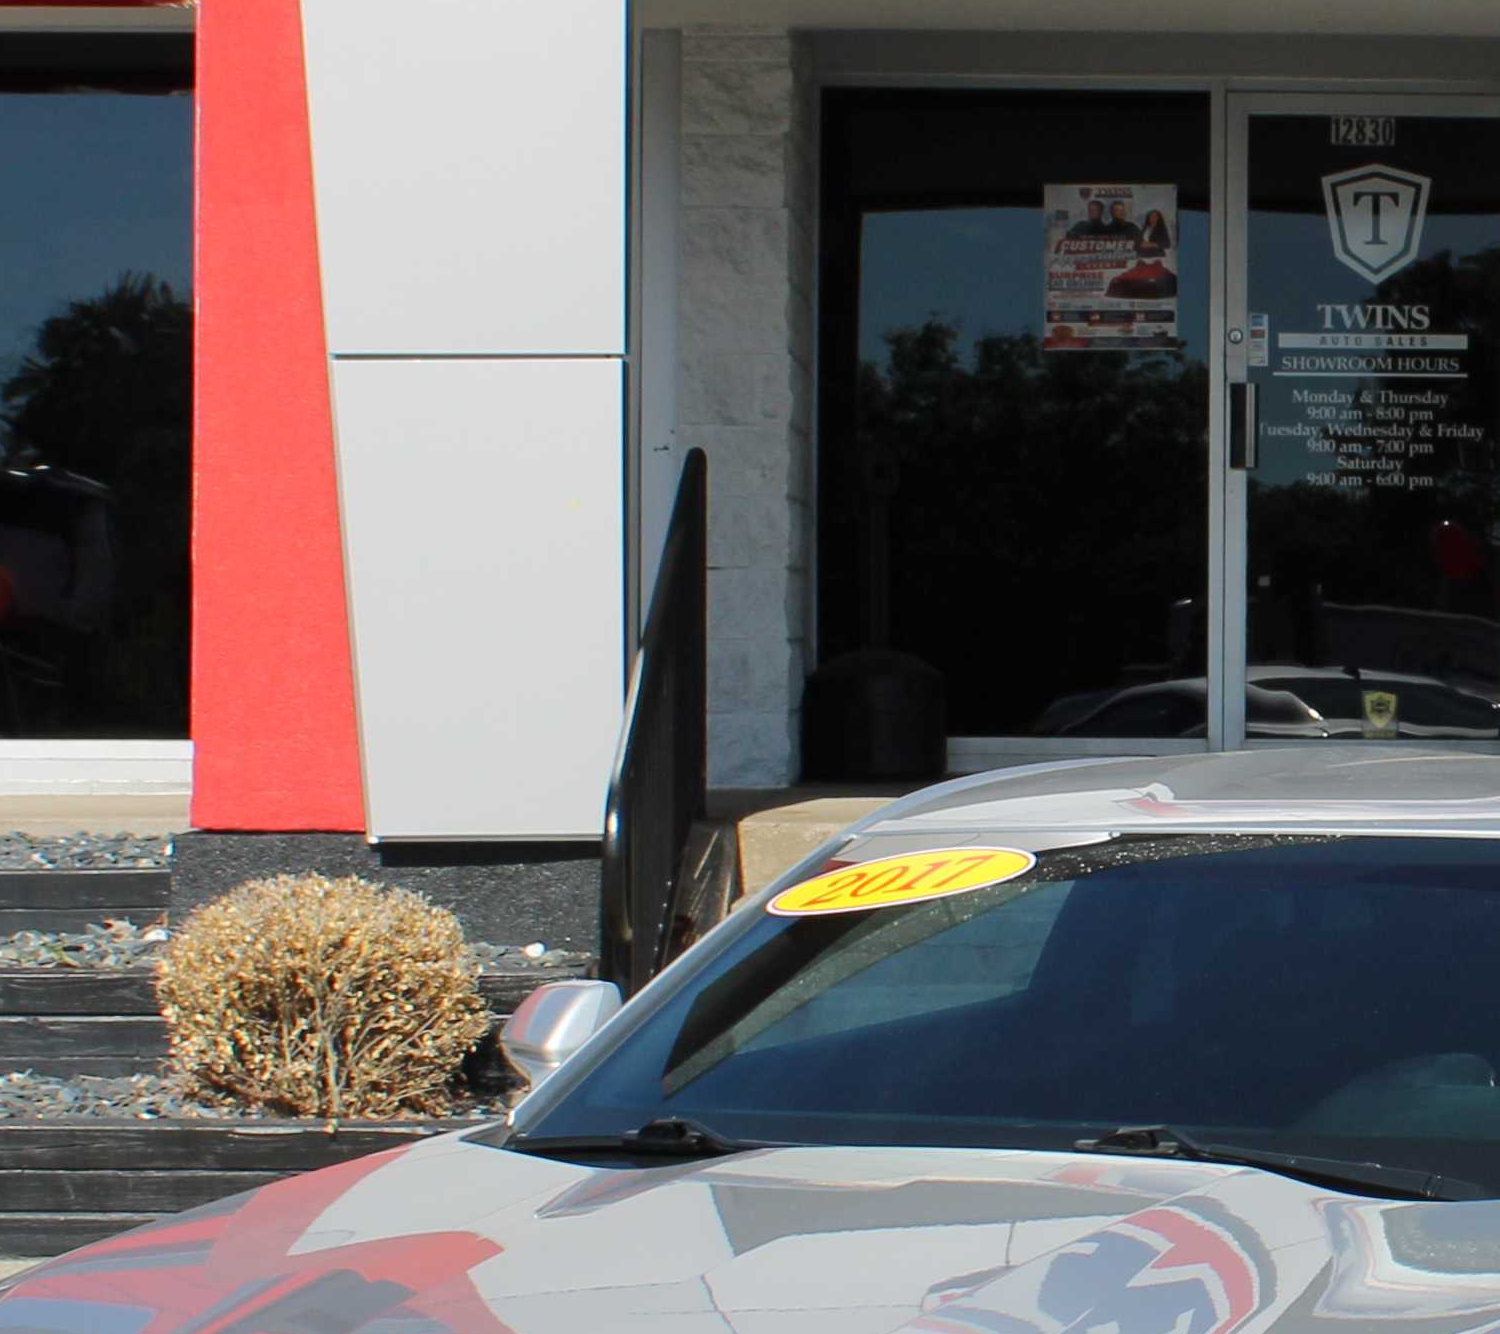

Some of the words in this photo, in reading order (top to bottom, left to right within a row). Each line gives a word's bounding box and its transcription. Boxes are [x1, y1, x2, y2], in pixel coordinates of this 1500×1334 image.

[1334, 119, 1394, 144] 12830
[1353, 192, 1399, 245] T
[1060, 240, 1135, 251] CUSTOMER
[1316, 304, 1430, 329] TWINS
[1319, 336, 1363, 346] AUTO
[1375, 336, 1428, 347] SALES
[1282, 355, 1392, 371] SHOWROOM
[1398, 357, 1460, 372] HOURS
[1292, 389, 1354, 405] Monday
[1360, 391, 1373, 404] &
[1379, 390, 1449, 407] Thursday
[1306, 407, 1336, 419] 9:00
[1339, 410, 1363, 419] am
[1375, 408, 1404, 420] 8:00
[1409, 410, 1434, 423] pm
[1327, 423, 1413, 439] Wednesday
[1420, 425, 1432, 437] &
[1437, 424, 1484, 440] Friday
[1306, 440, 1336, 452] 9:00
[1339, 443, 1363, 452] am
[1376, 441, 1404, 453] 7:00
[1409, 443, 1434, 456] pm
[1337, 456, 1403, 470] Saturday
[1306, 473, 1336, 485] 9:00
[1339, 476, 1363, 485] am
[1375, 474, 1404, 486] 6:00
[1409, 476, 1434, 489] pm
[799, 854, 997, 908] 2017
